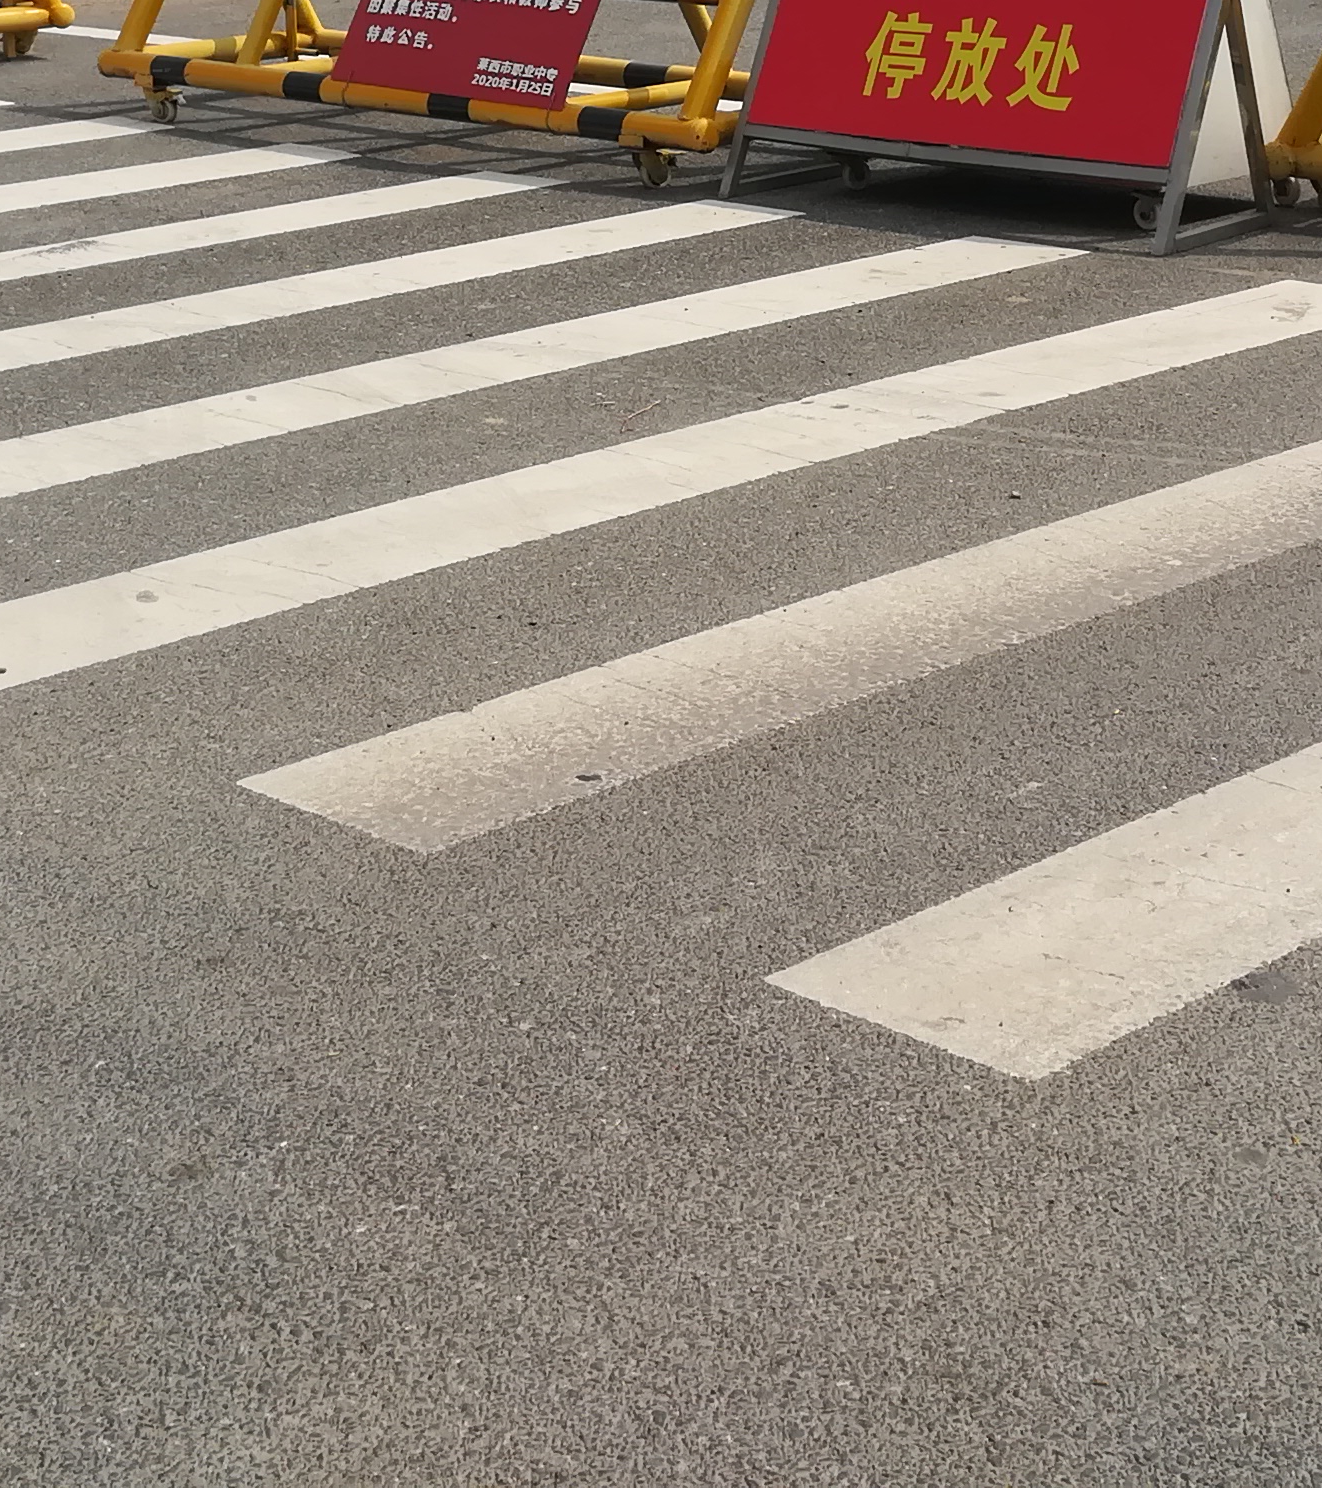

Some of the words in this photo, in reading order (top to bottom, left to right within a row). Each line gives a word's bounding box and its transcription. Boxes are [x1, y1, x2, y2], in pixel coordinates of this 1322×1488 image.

[476, 57, 559, 81] 莱西市职业中专
[861, 11, 1080, 111] 停放处
[471, 73, 553, 97] 2020年1月25日
